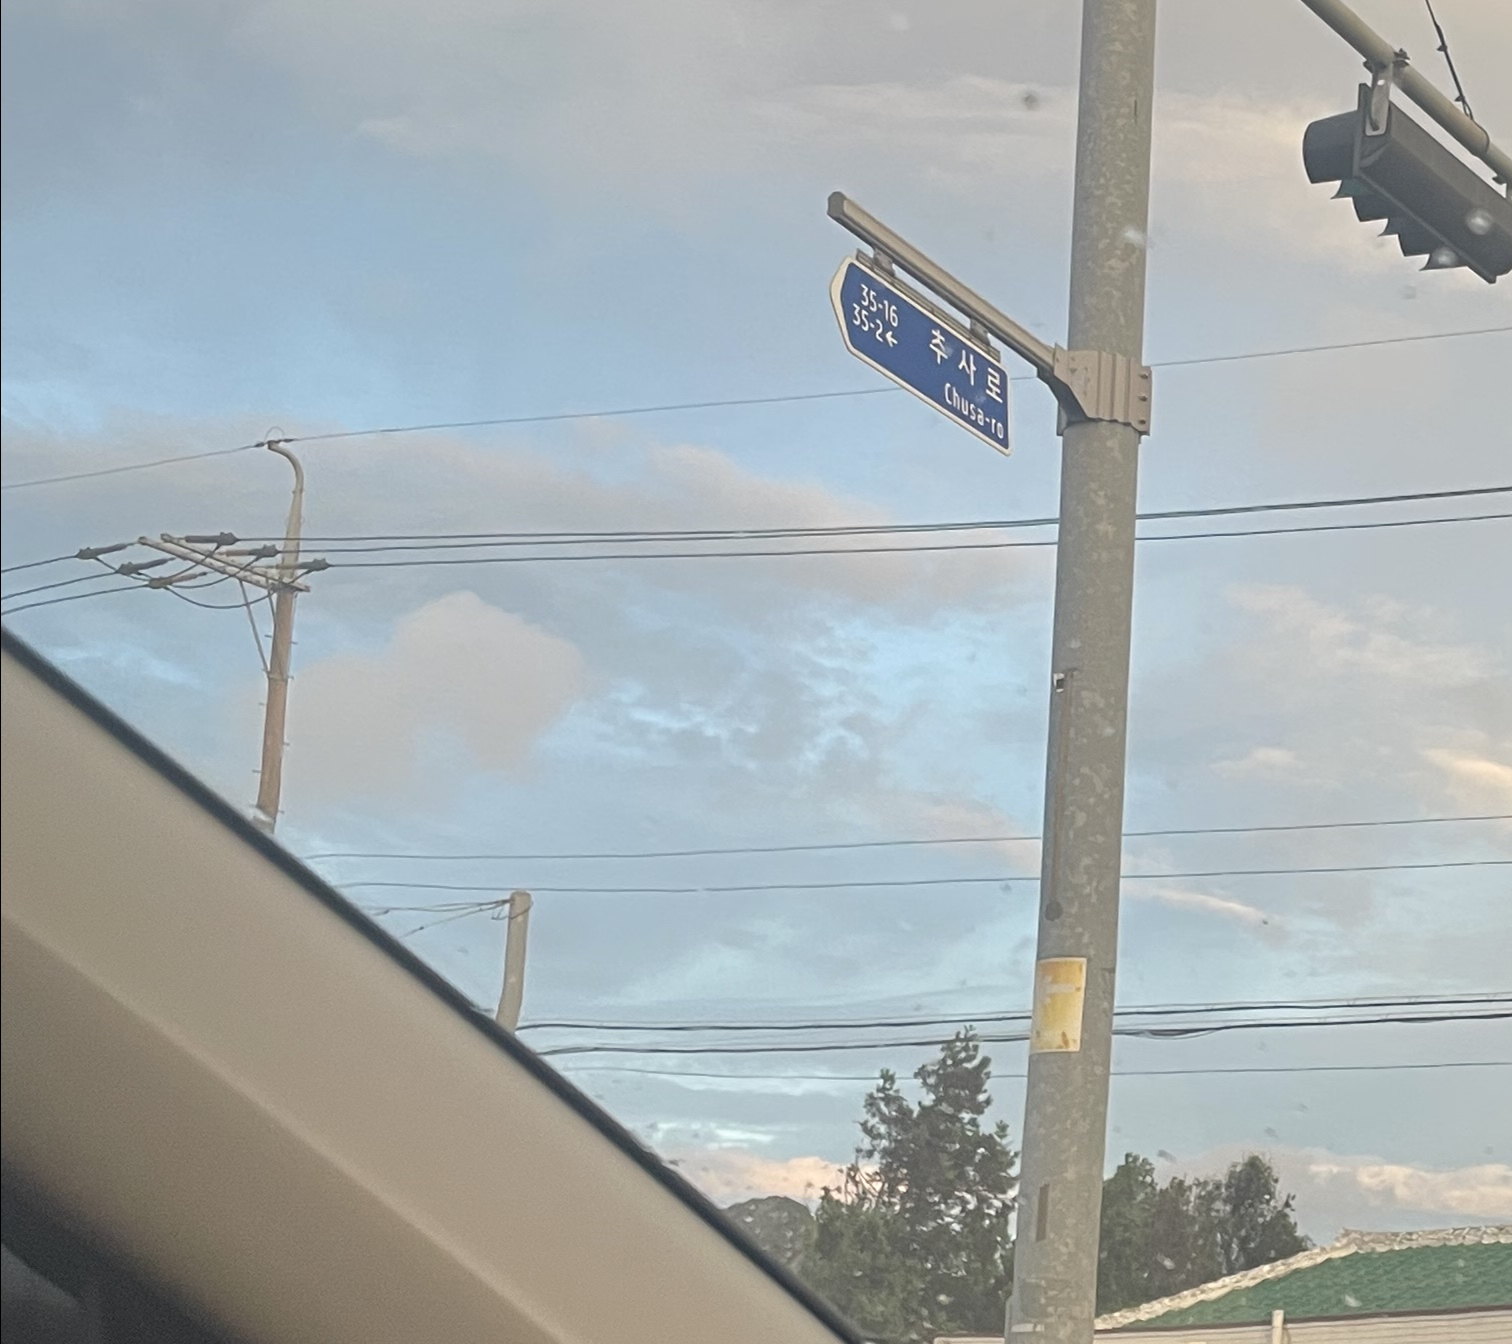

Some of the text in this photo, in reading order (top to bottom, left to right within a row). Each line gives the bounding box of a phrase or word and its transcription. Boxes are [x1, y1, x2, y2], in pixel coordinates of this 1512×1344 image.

[852, 303, 884, 343] 35-2
[860, 283, 899, 327] 35-16
[929, 328, 1004, 404] 추사로
[944, 382, 1005, 439] Chusa-ro
